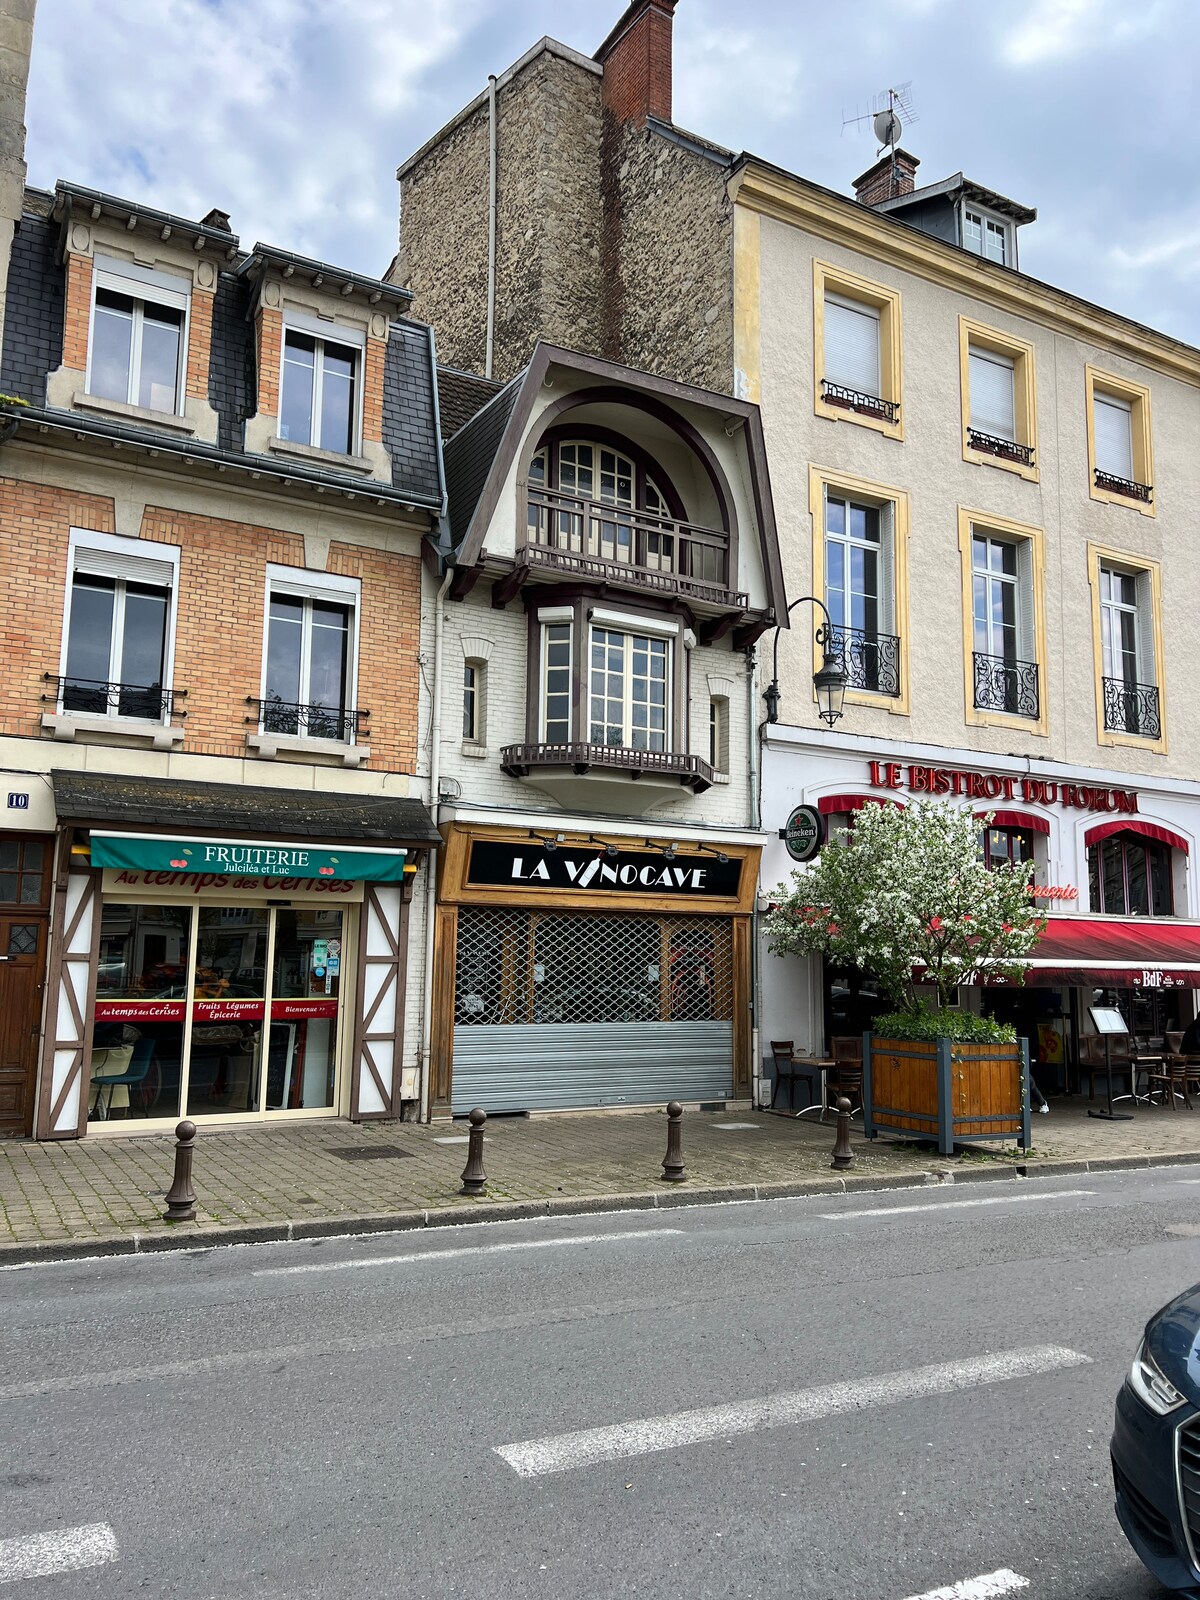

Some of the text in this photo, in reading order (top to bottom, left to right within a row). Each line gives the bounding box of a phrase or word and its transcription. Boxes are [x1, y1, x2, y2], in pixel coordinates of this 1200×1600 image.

[868, 761, 1141, 814] LE BISTROT DU FORUM
[12, 795, 25, 806] 10
[787, 828, 814, 838] Heineken
[204, 846, 310, 867] FRUITERIE
[223, 862, 290, 875] Julciléa et Luc
[511, 857, 551, 879] LA
[114, 869, 354, 894] Au temps des Cerises
[1142, 970, 1164, 988] BdF
[111, 1008, 138, 1017] temps
[149, 1004, 180, 1016] Cerises
[198, 1002, 259, 1011] Fruits Légumes
[209, 1010, 241, 1019] Épicerie
